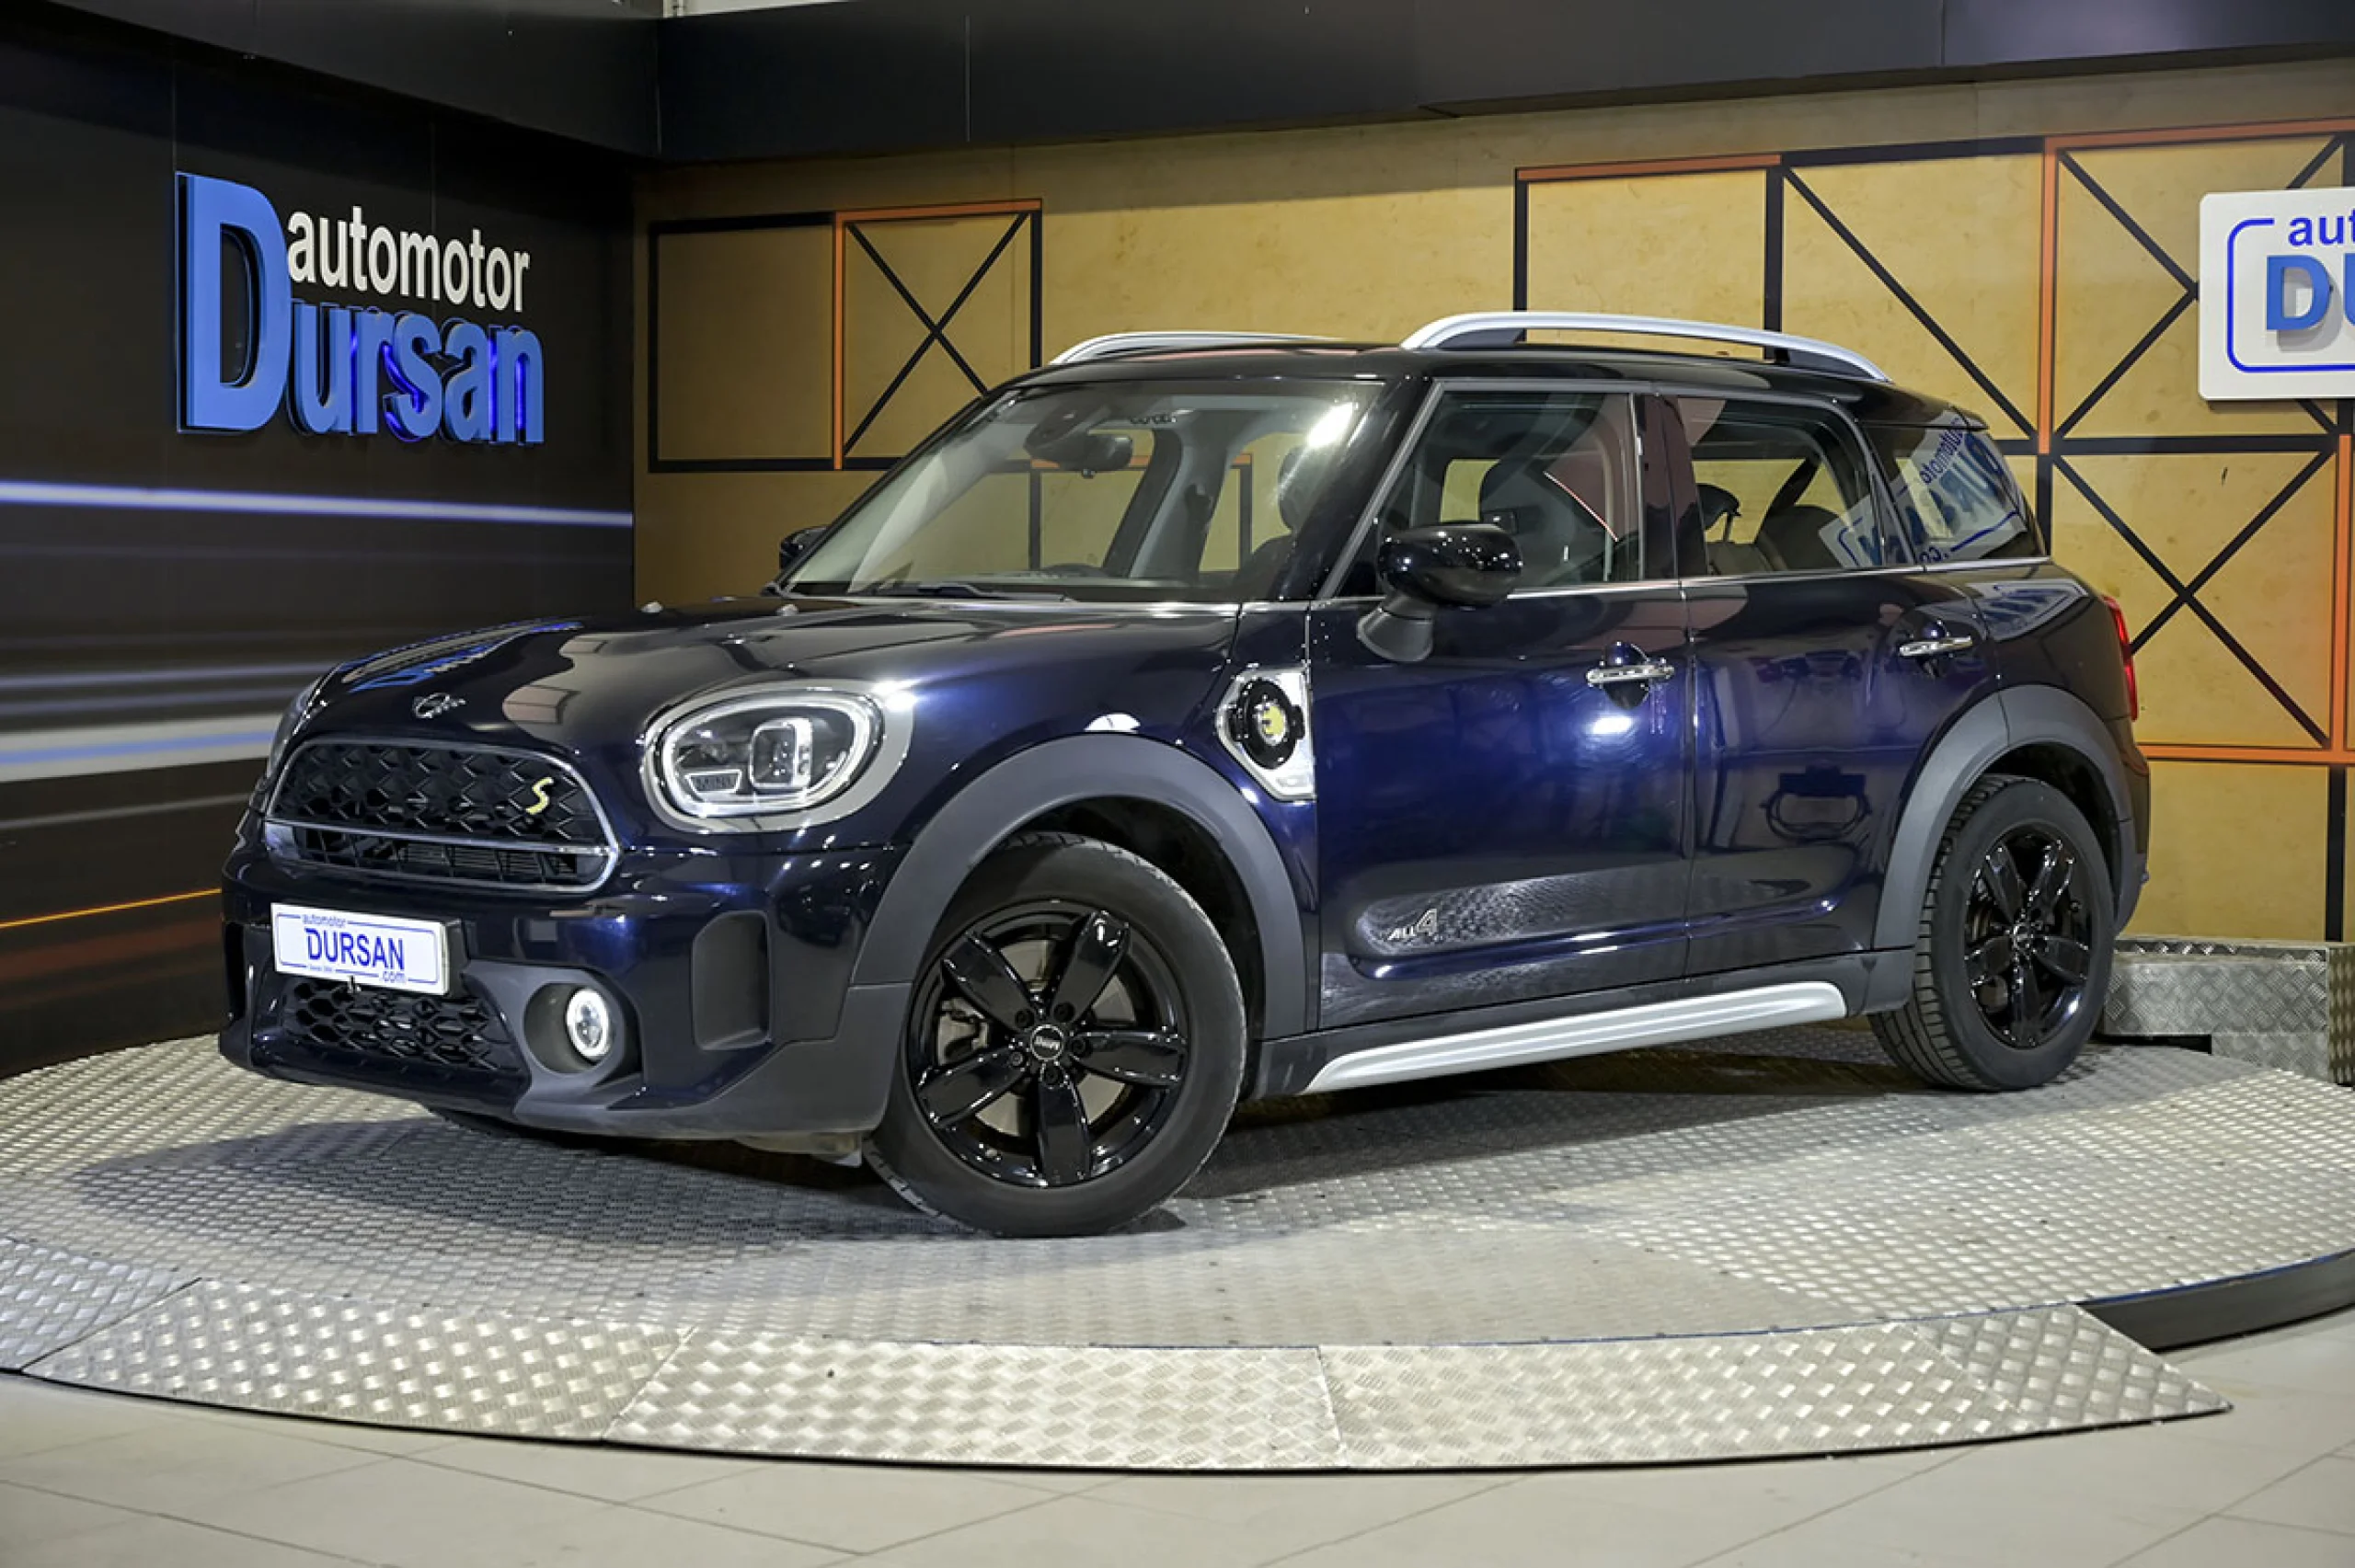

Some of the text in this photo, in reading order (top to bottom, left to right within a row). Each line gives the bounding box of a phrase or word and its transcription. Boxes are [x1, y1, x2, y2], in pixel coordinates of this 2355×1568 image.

[288, 206, 530, 312] automotor
[176, 171, 545, 445] Dursan
[525, 776, 555, 816] S
[302, 913, 346, 929] automotor
[304, 927, 405, 971] DURSAN
